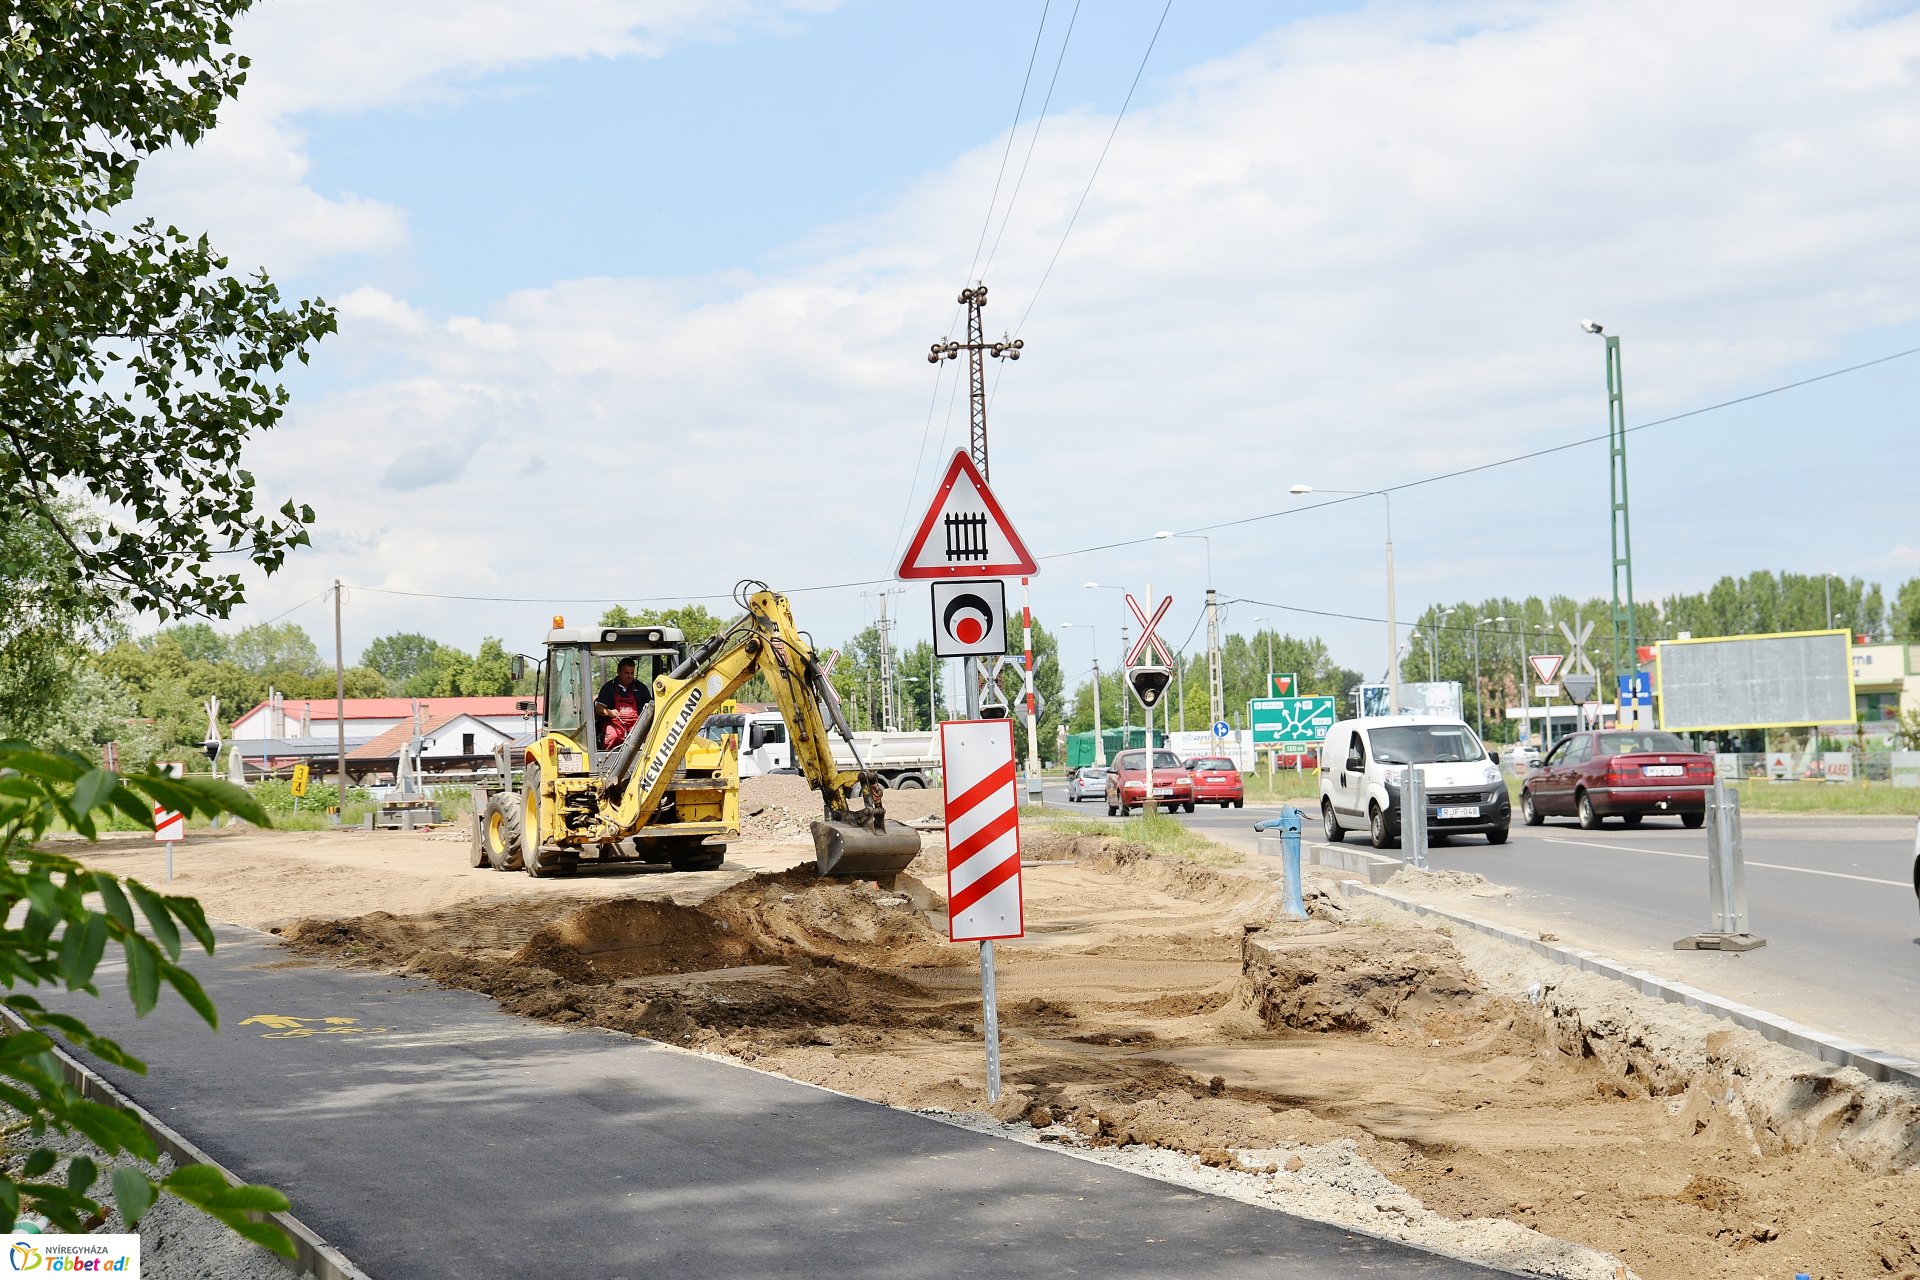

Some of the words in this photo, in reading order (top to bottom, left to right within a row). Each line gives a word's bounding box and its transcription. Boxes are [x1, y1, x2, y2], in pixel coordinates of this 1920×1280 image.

[640, 757, 664, 793] NEW
[660, 687, 703, 758] HOLLAND
[296, 768, 304, 780] 3
[295, 782, 302, 792] 4
[1443, 807, 1478, 816] RJF-048
